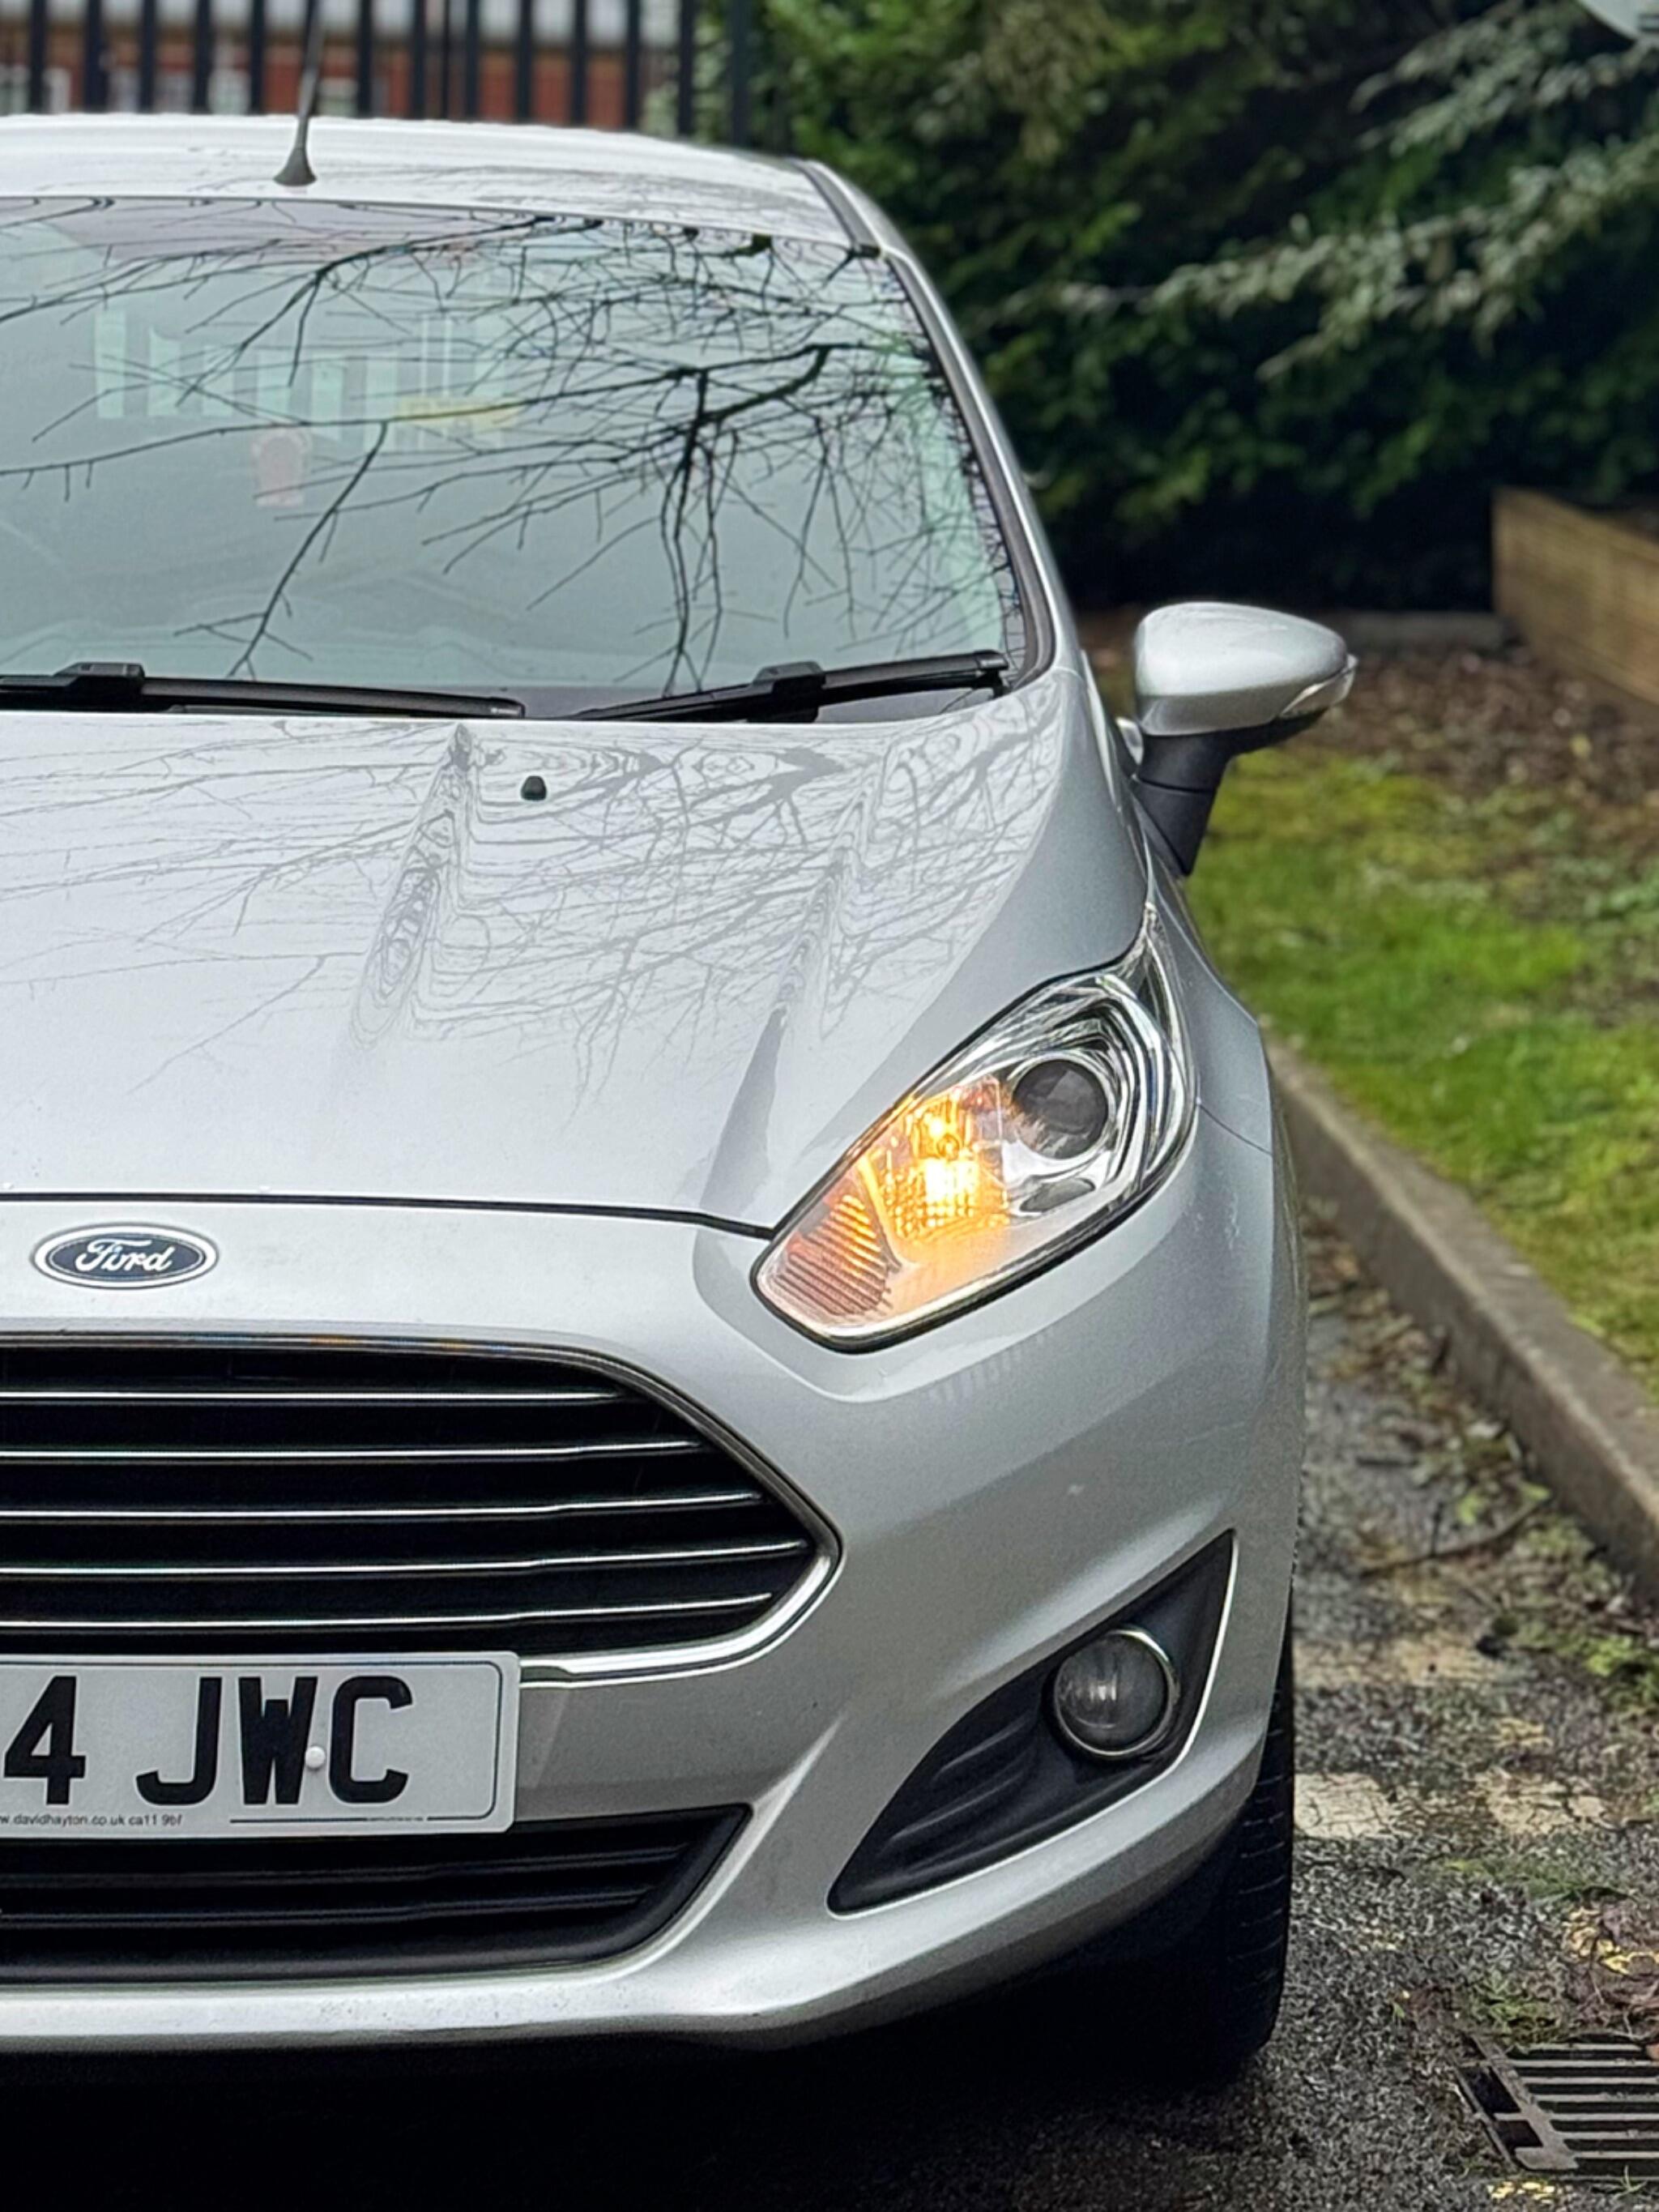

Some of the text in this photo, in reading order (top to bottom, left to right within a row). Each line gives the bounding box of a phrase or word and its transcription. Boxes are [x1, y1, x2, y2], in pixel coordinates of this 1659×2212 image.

[75, 1238, 175, 1271] Ford
[3, 1675, 414, 1806] 4 JWC
